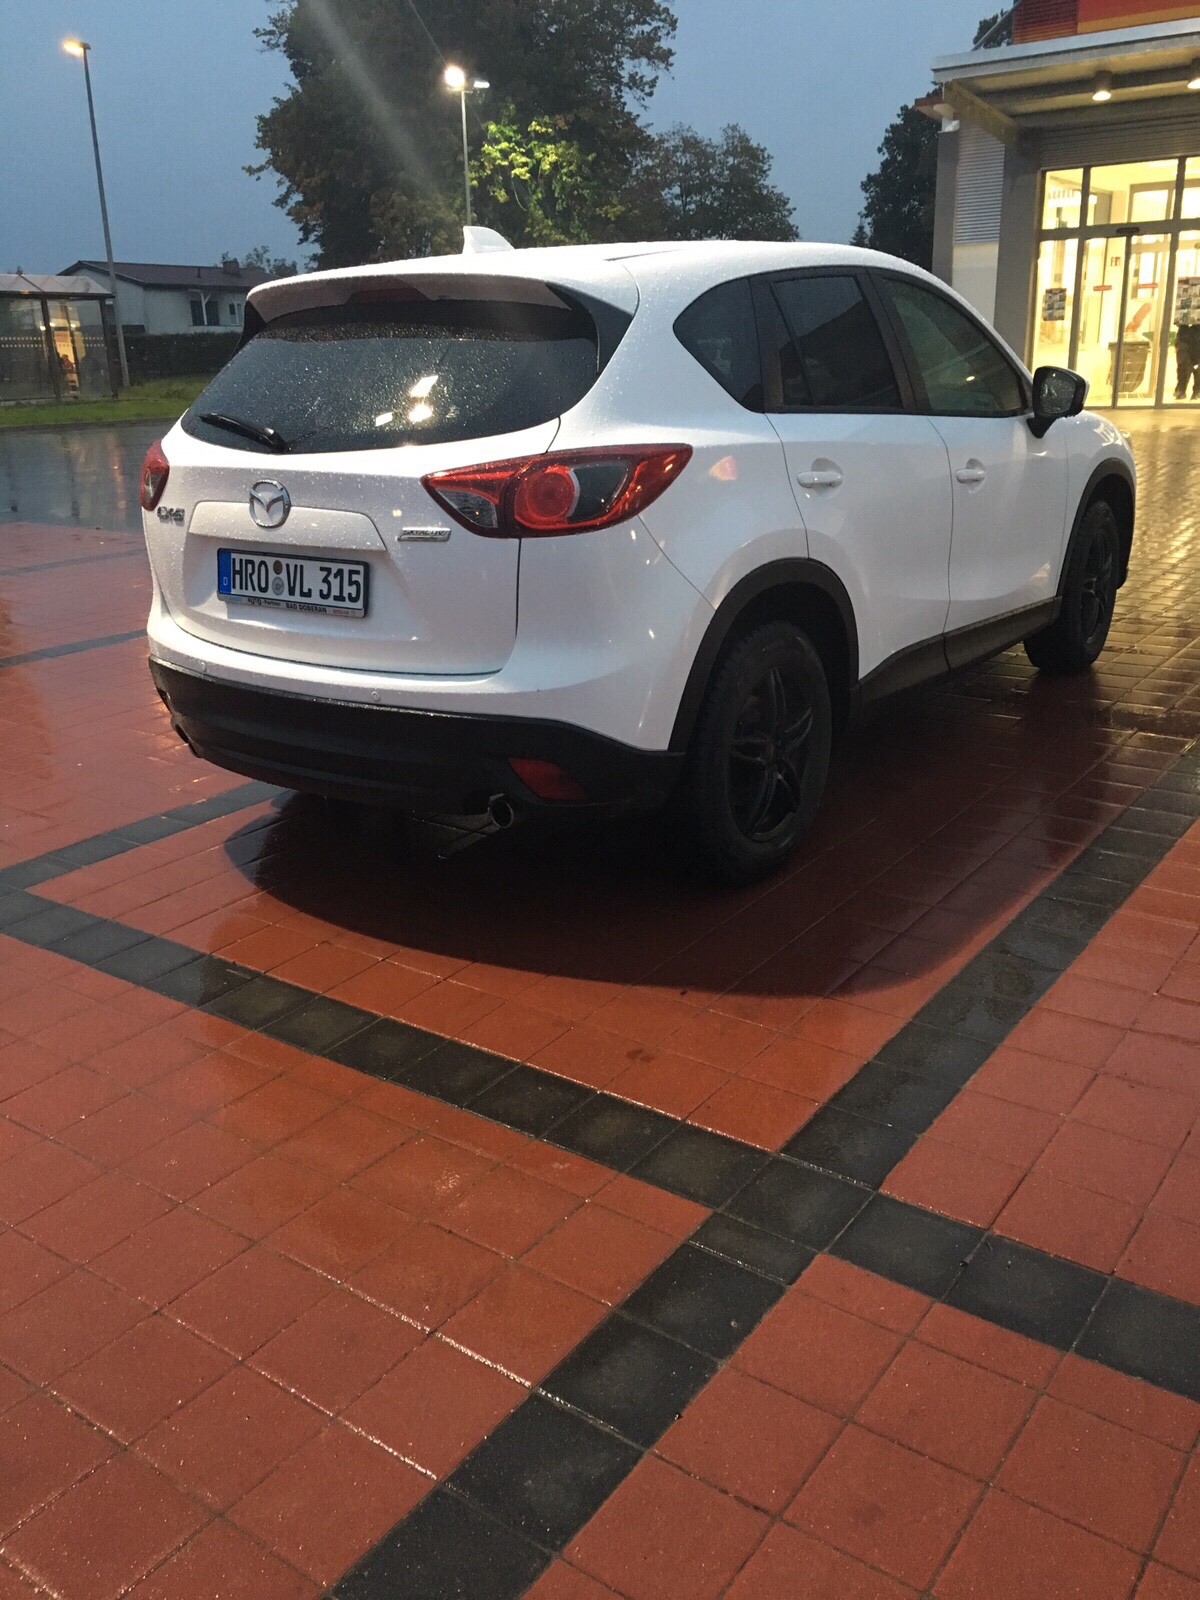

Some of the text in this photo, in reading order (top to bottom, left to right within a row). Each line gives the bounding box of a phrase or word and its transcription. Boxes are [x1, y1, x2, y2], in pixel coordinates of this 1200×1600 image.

[222, 576, 229, 586] D
[231, 557, 361, 603] HRO VL 315
[285, 602, 298, 610] BAD
[298, 603, 327, 614] DOBERAN
